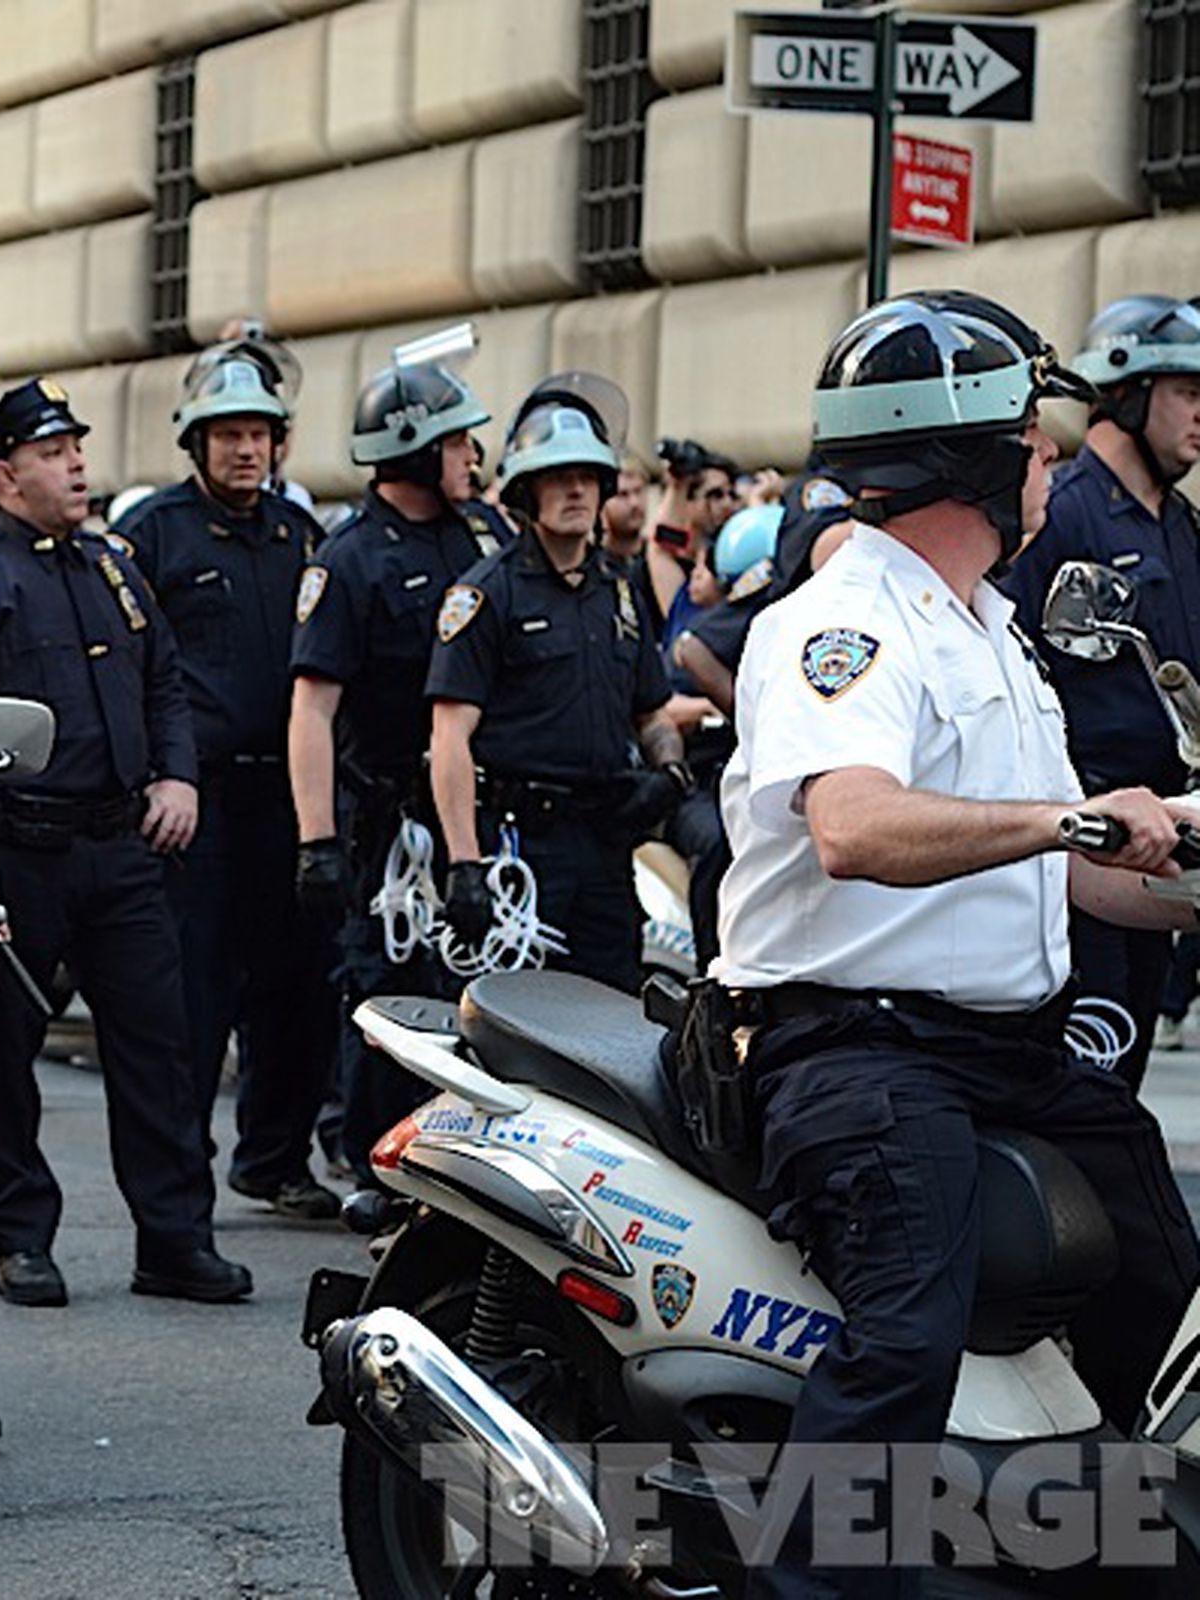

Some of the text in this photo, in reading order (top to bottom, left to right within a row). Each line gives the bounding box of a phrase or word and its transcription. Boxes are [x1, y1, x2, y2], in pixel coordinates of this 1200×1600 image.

[776, 44, 988, 90] ONE WAY
[915, 143, 971, 174] STOPPING
[902, 169, 959, 202] ANYTIME
